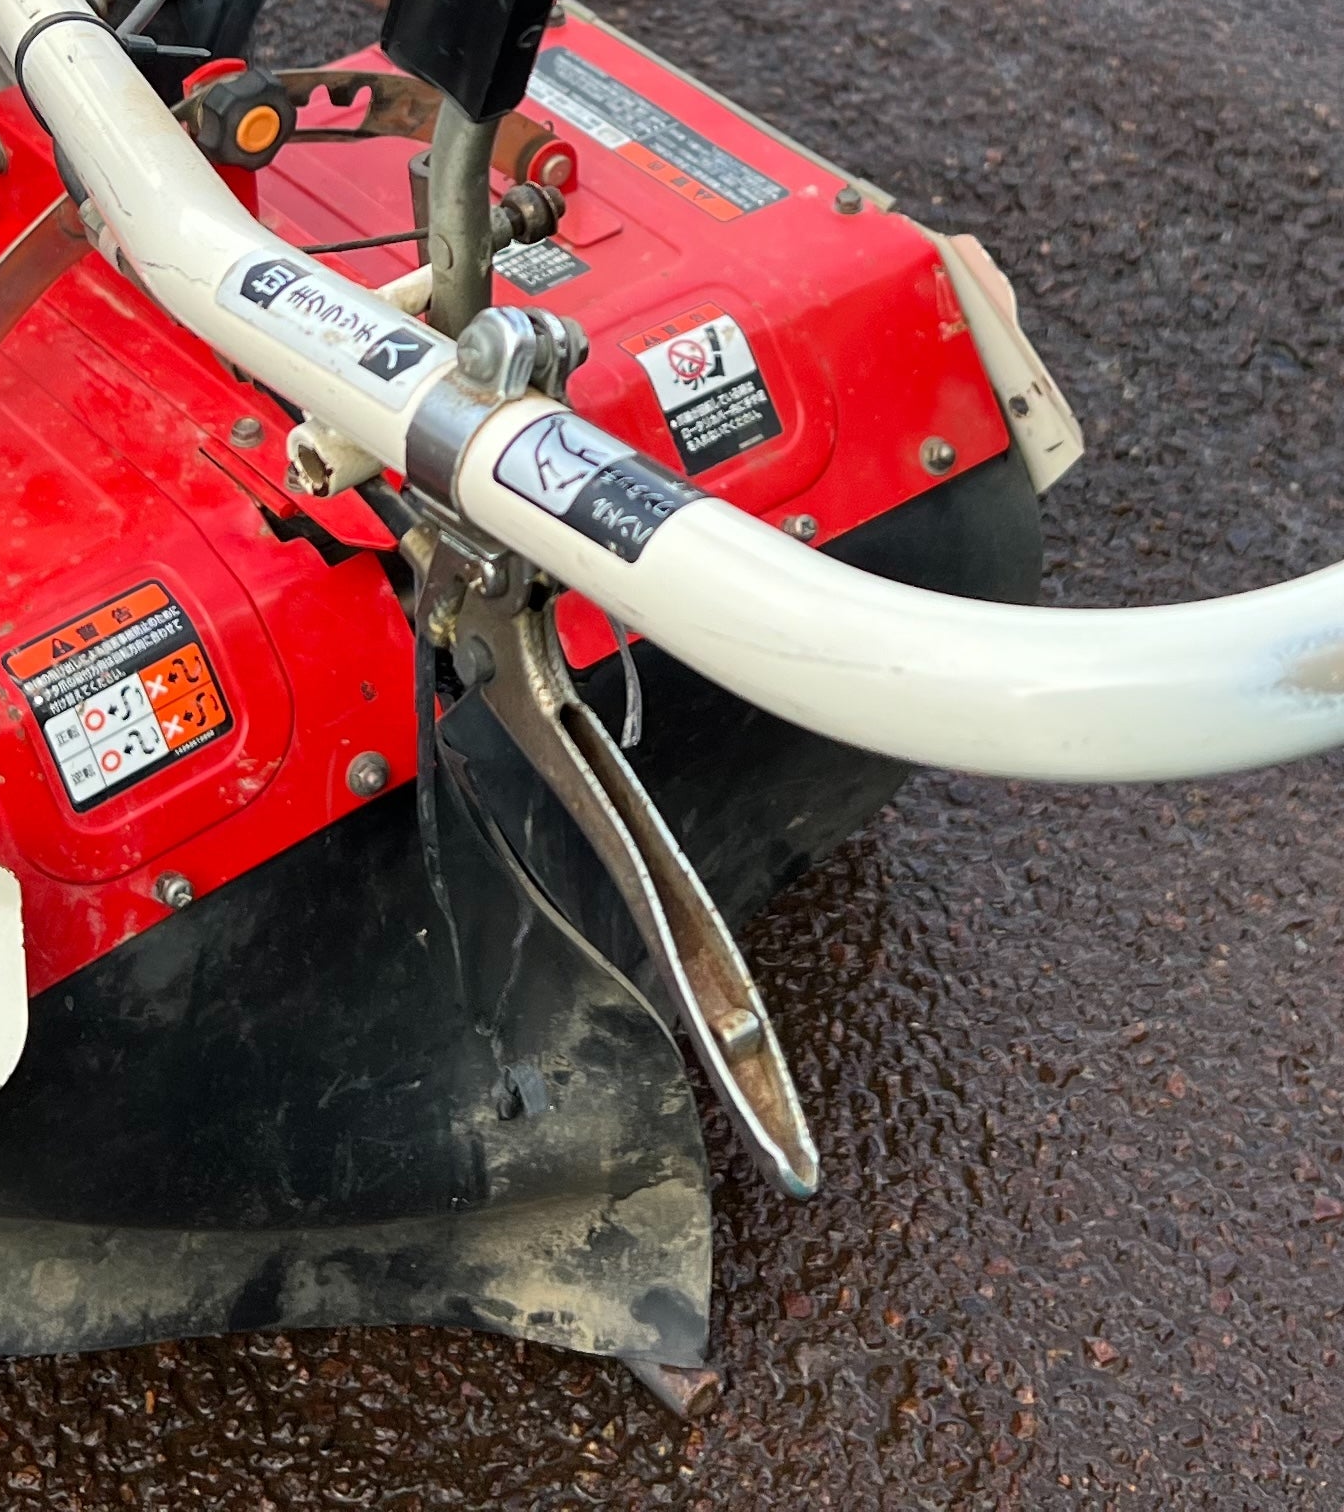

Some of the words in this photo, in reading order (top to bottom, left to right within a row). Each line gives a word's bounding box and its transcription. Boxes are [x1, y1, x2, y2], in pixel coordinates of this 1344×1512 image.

[253, 262, 301, 296] 切
[591, 496, 654, 545] ハンドル
